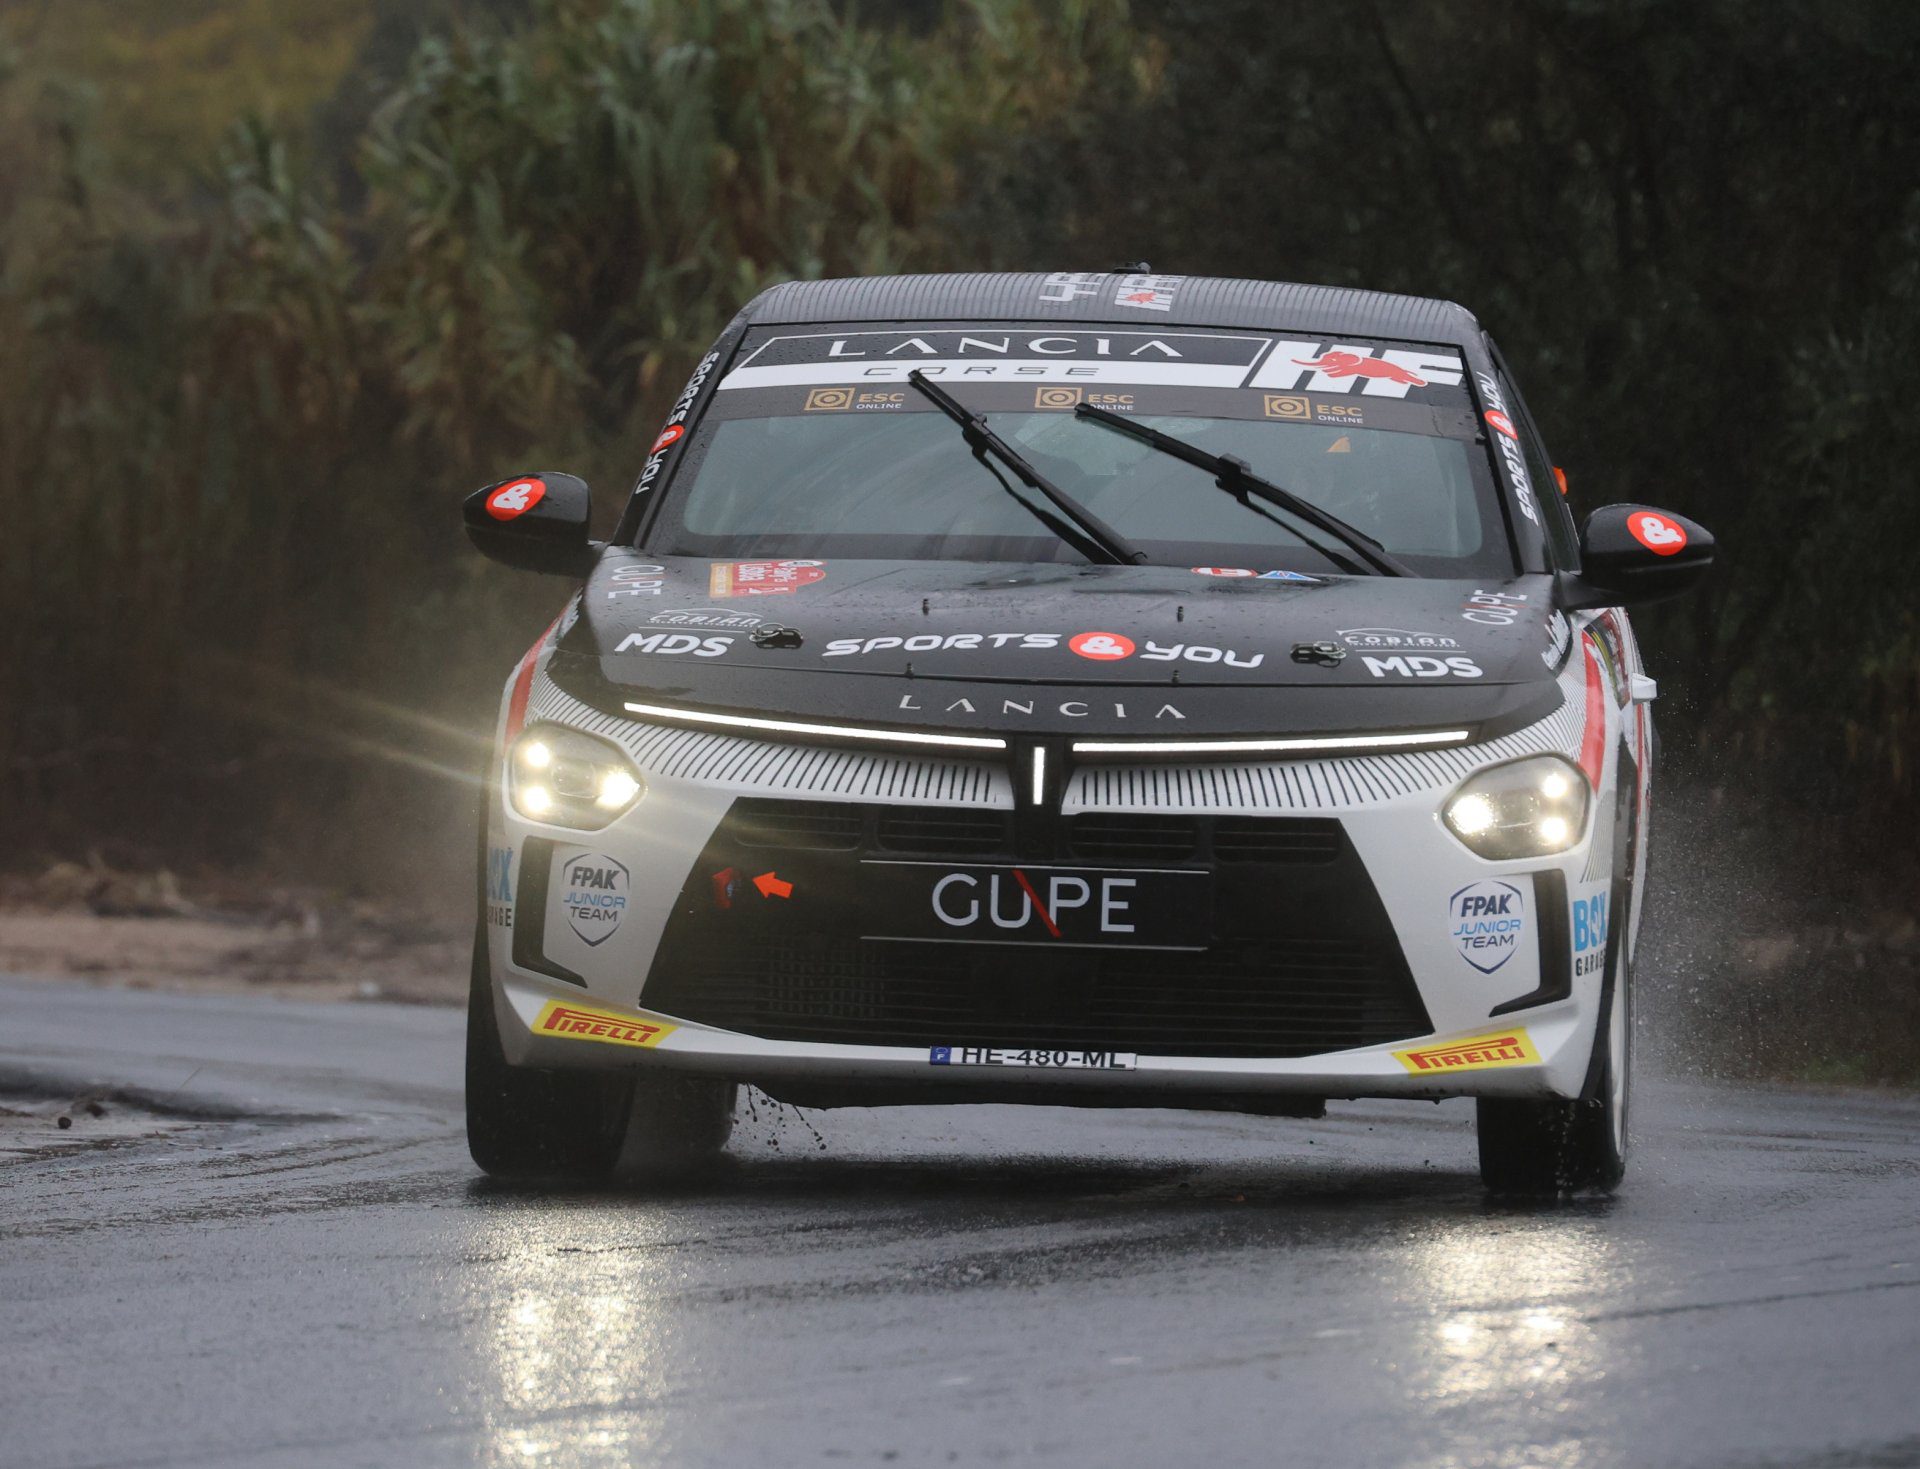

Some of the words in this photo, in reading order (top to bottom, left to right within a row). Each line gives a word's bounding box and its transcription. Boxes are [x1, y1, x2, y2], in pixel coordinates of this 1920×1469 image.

[828, 337, 1183, 357] LANCIA
[863, 366, 1100, 377] CORSE
[667, 351, 720, 426] SPORTS
[858, 392, 905, 403] ESC
[1088, 393, 1134, 404] ESC
[856, 402, 902, 410] ONLINE
[1316, 404, 1363, 417] ESC
[1317, 414, 1364, 424] ONLINE
[1498, 432, 1539, 526] SPORTS
[614, 632, 735, 658] MDS
[821, 633, 1063, 657] SPORTS
[1361, 656, 1484, 678] MDS
[899, 694, 1186, 719] LANCIA
[570, 865, 620, 891] FPAK
[563, 891, 627, 909] JUNIOR
[1460, 893, 1512, 918] FPAK
[569, 906, 618, 922] TEAM
[1453, 919, 1522, 936] JUNIOR
[1461, 934, 1515, 950] TEAM
[543, 1007, 661, 1043] PIRELLI
[962, 1047, 1127, 1069] HE-480-ML
[1406, 1037, 1526, 1070] PIRELLI
